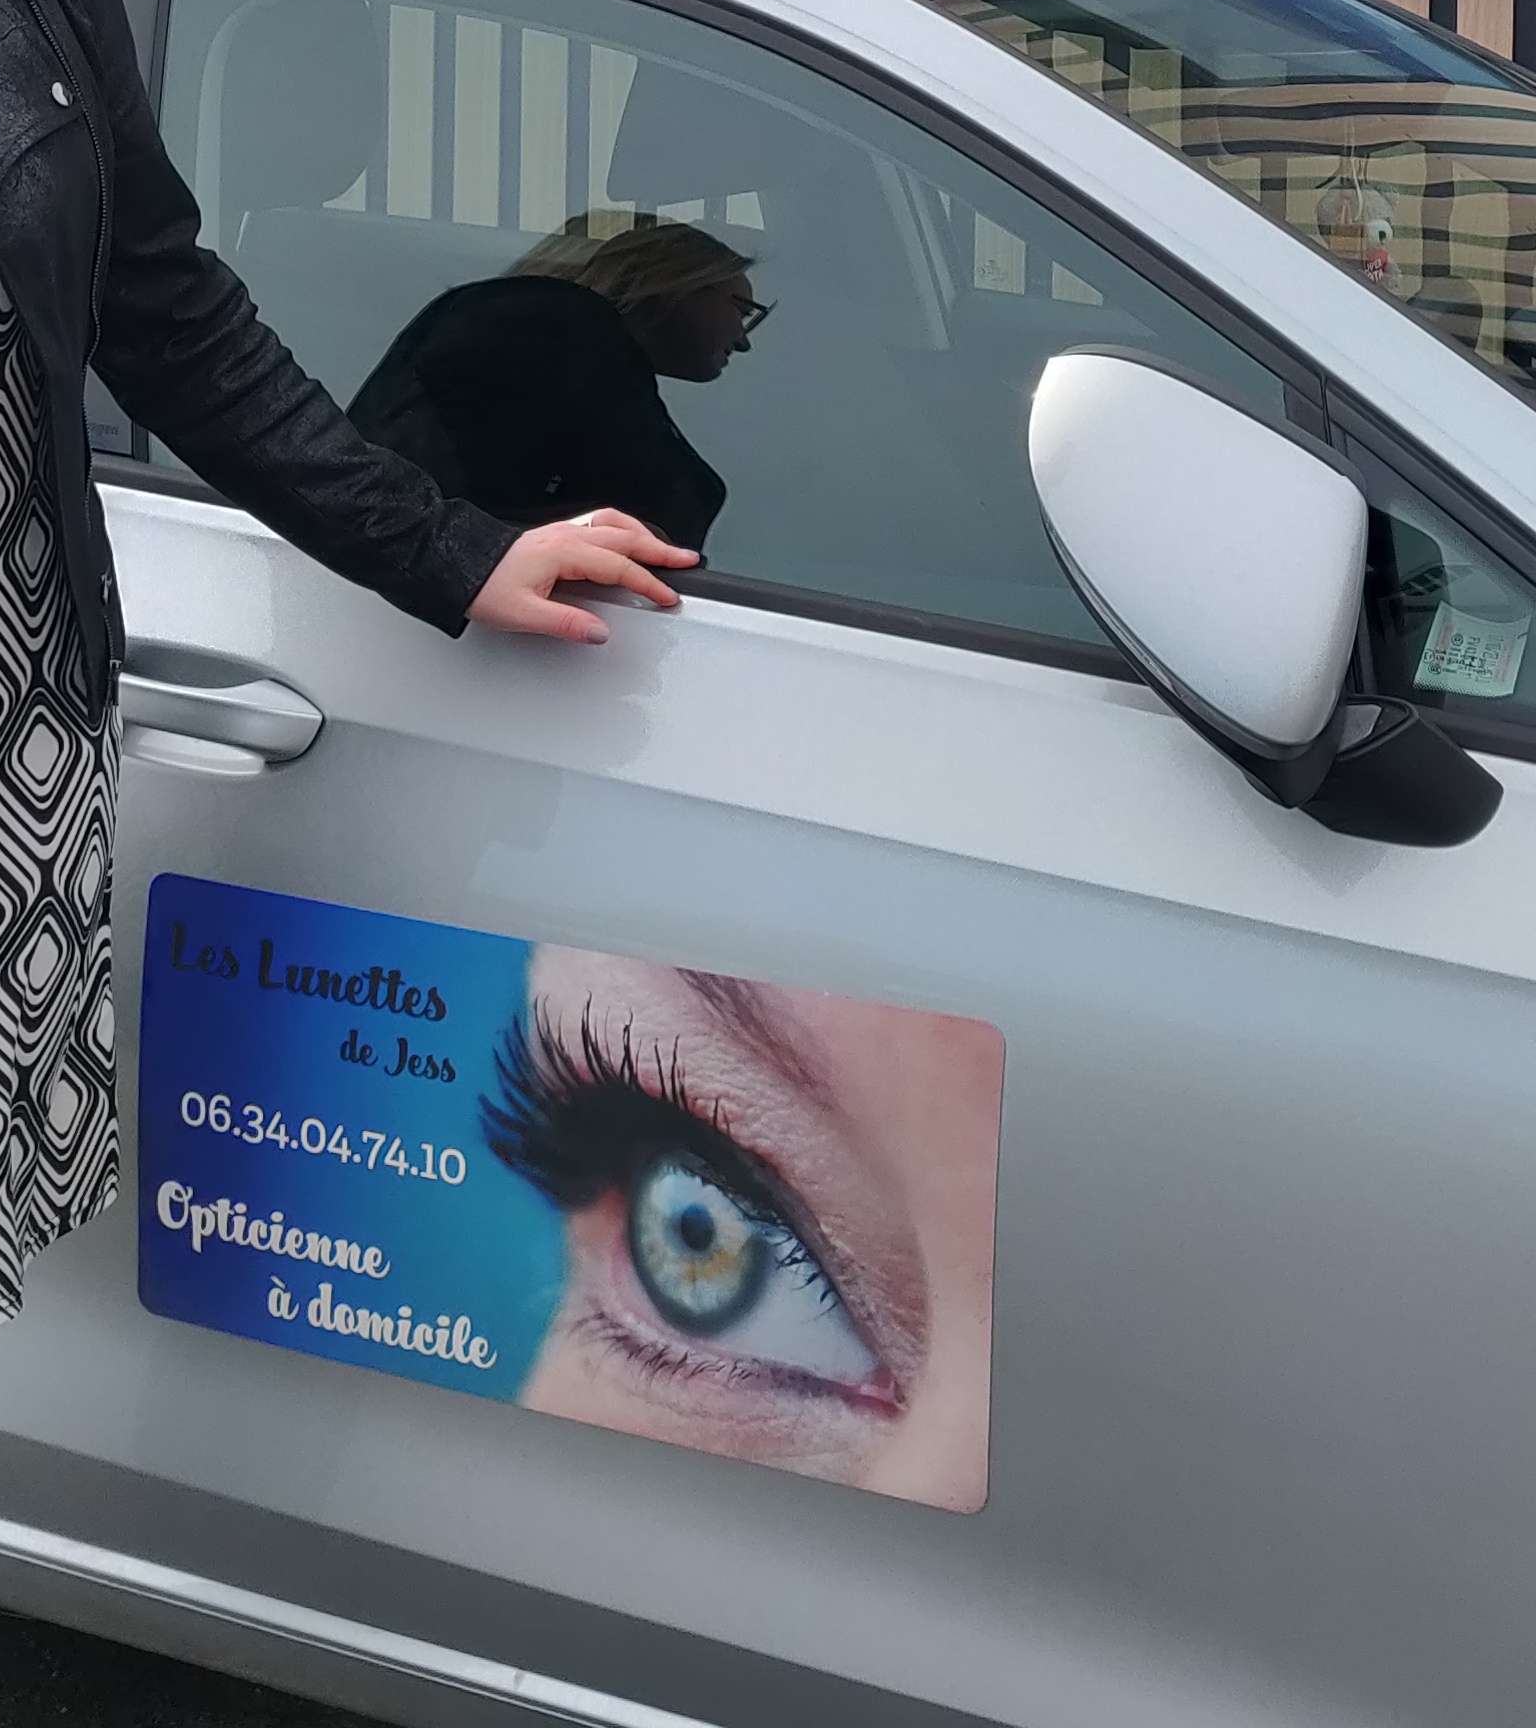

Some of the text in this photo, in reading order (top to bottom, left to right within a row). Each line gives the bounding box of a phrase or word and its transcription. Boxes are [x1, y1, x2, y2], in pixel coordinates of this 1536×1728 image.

[171, 921, 446, 1022] Les Lunettes
[339, 1028, 456, 1083] de Jess
[180, 1091, 466, 1185] 06.34.04.74.10
[156, 1180, 391, 1279] Opticienne
[267, 1275, 497, 1369] à domicile
